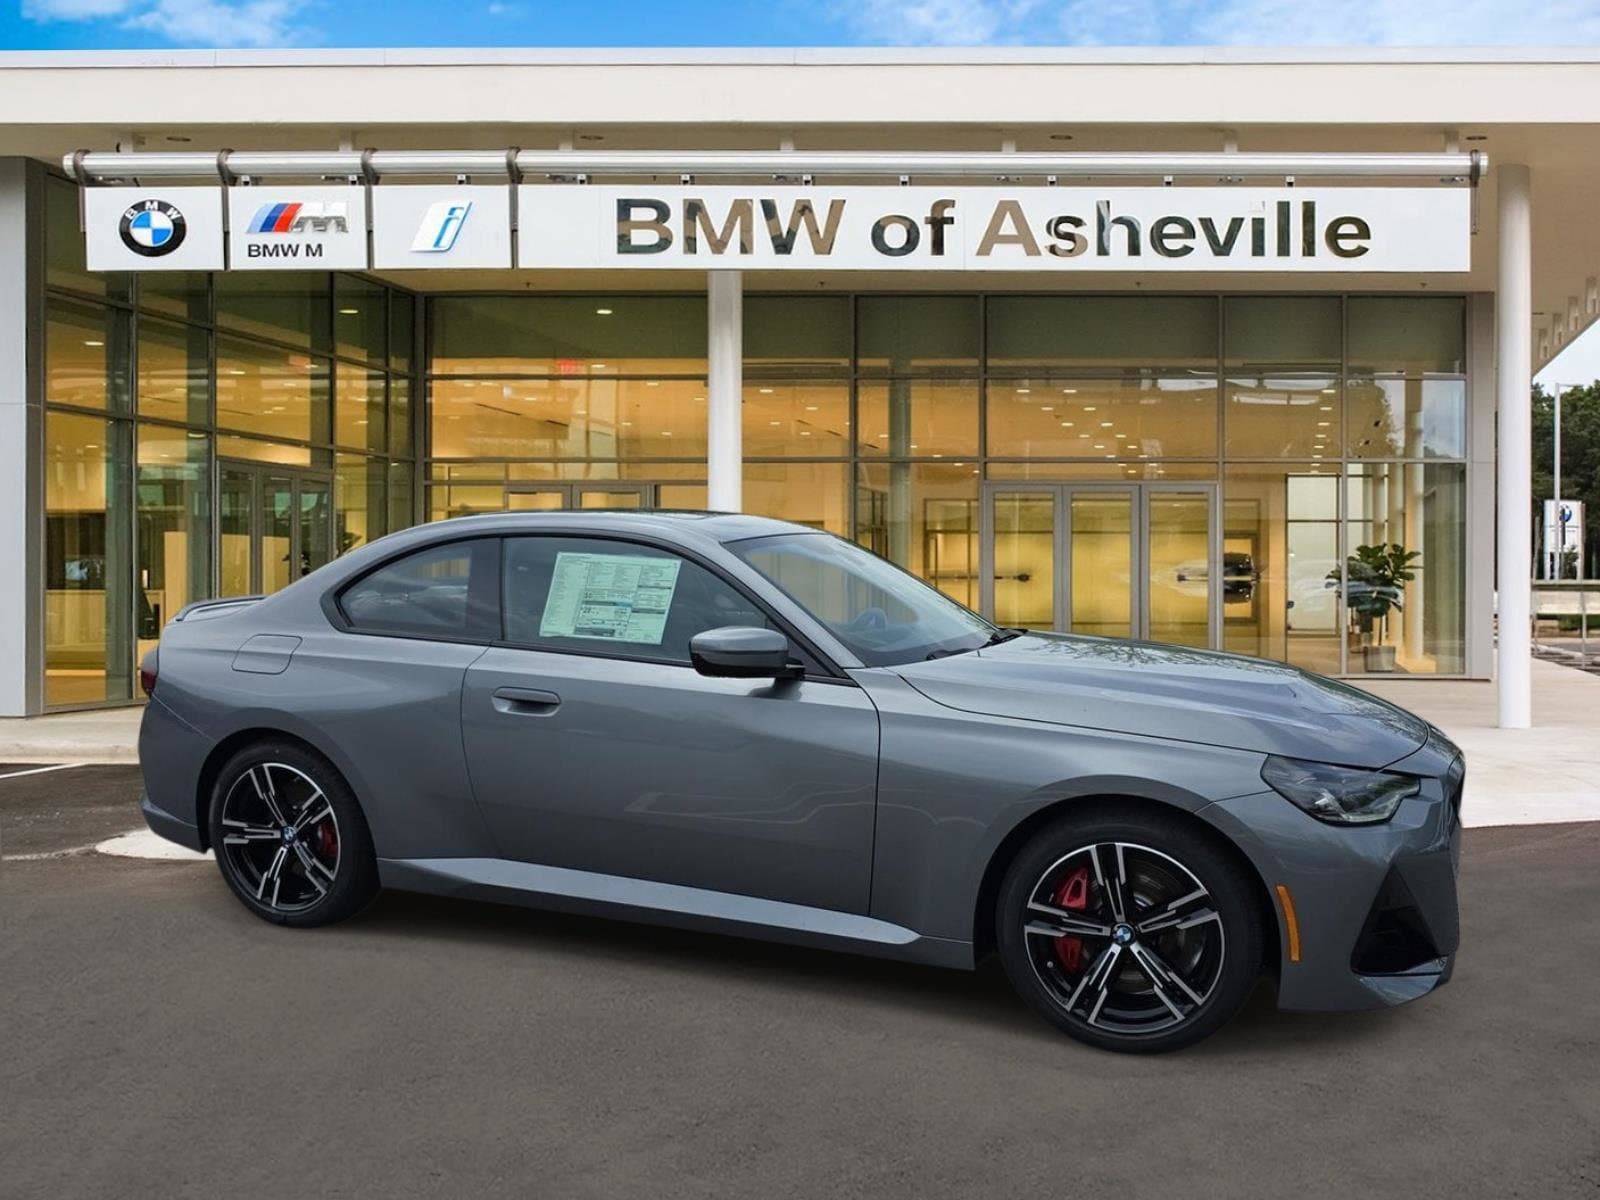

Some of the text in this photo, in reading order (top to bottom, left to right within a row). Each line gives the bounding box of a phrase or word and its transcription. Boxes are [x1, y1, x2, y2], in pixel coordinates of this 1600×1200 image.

[125, 200, 181, 220] BMW
[616, 198, 1372, 258] BMW of Asheville
[247, 243, 323, 258] BMW M
